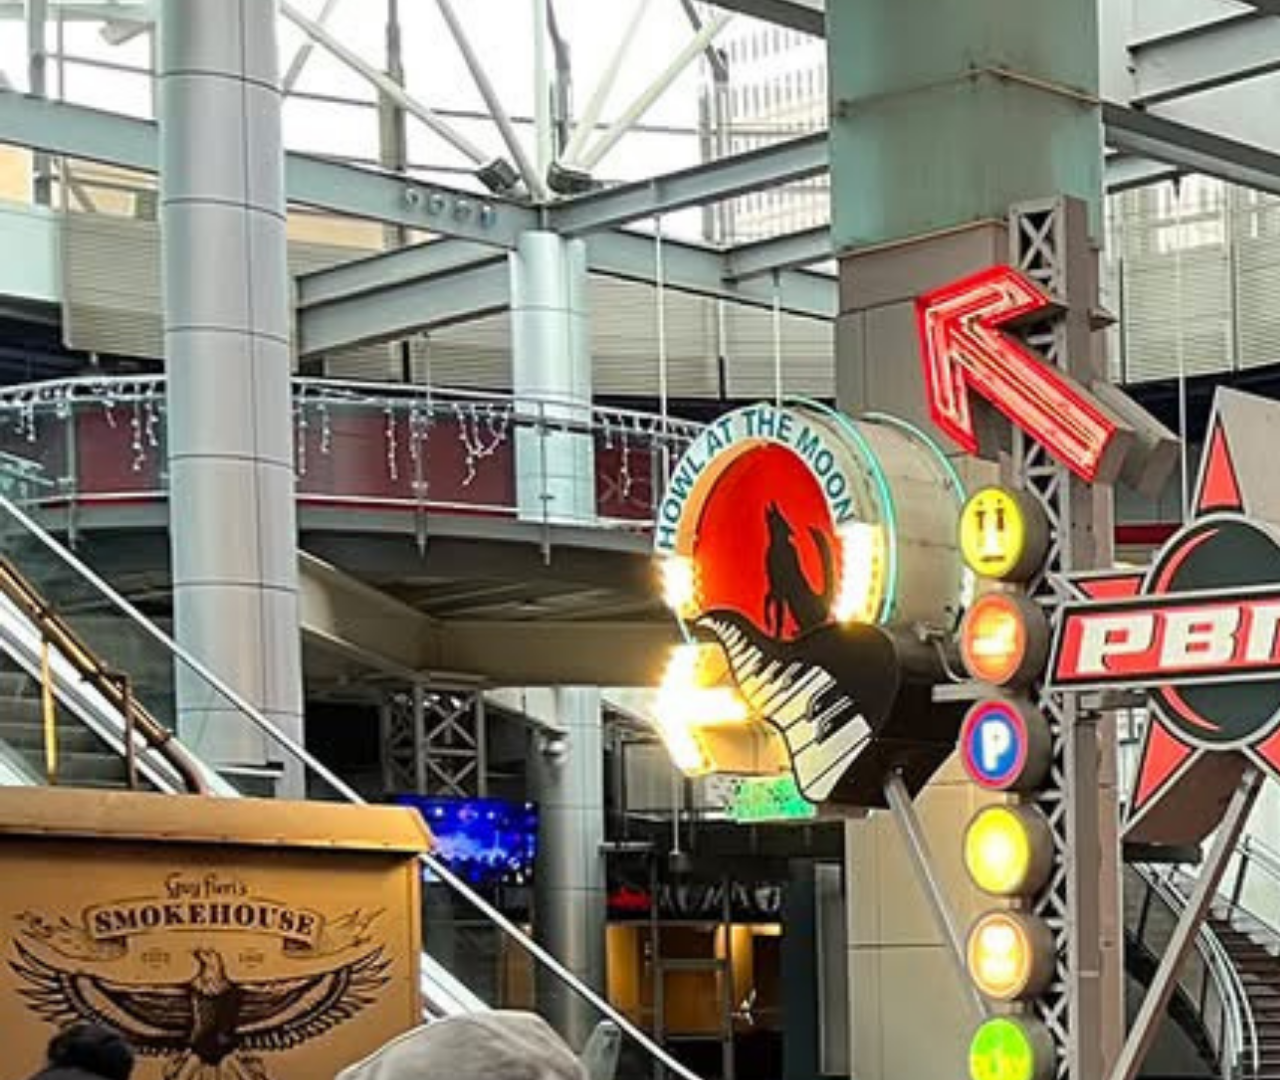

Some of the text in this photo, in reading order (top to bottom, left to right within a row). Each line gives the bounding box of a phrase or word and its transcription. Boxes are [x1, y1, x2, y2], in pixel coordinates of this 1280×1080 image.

[659, 409, 854, 549] HOWL AT THE MOON
[979, 719, 1012, 772] P
[95, 903, 315, 936] SMOKEHOUSE
